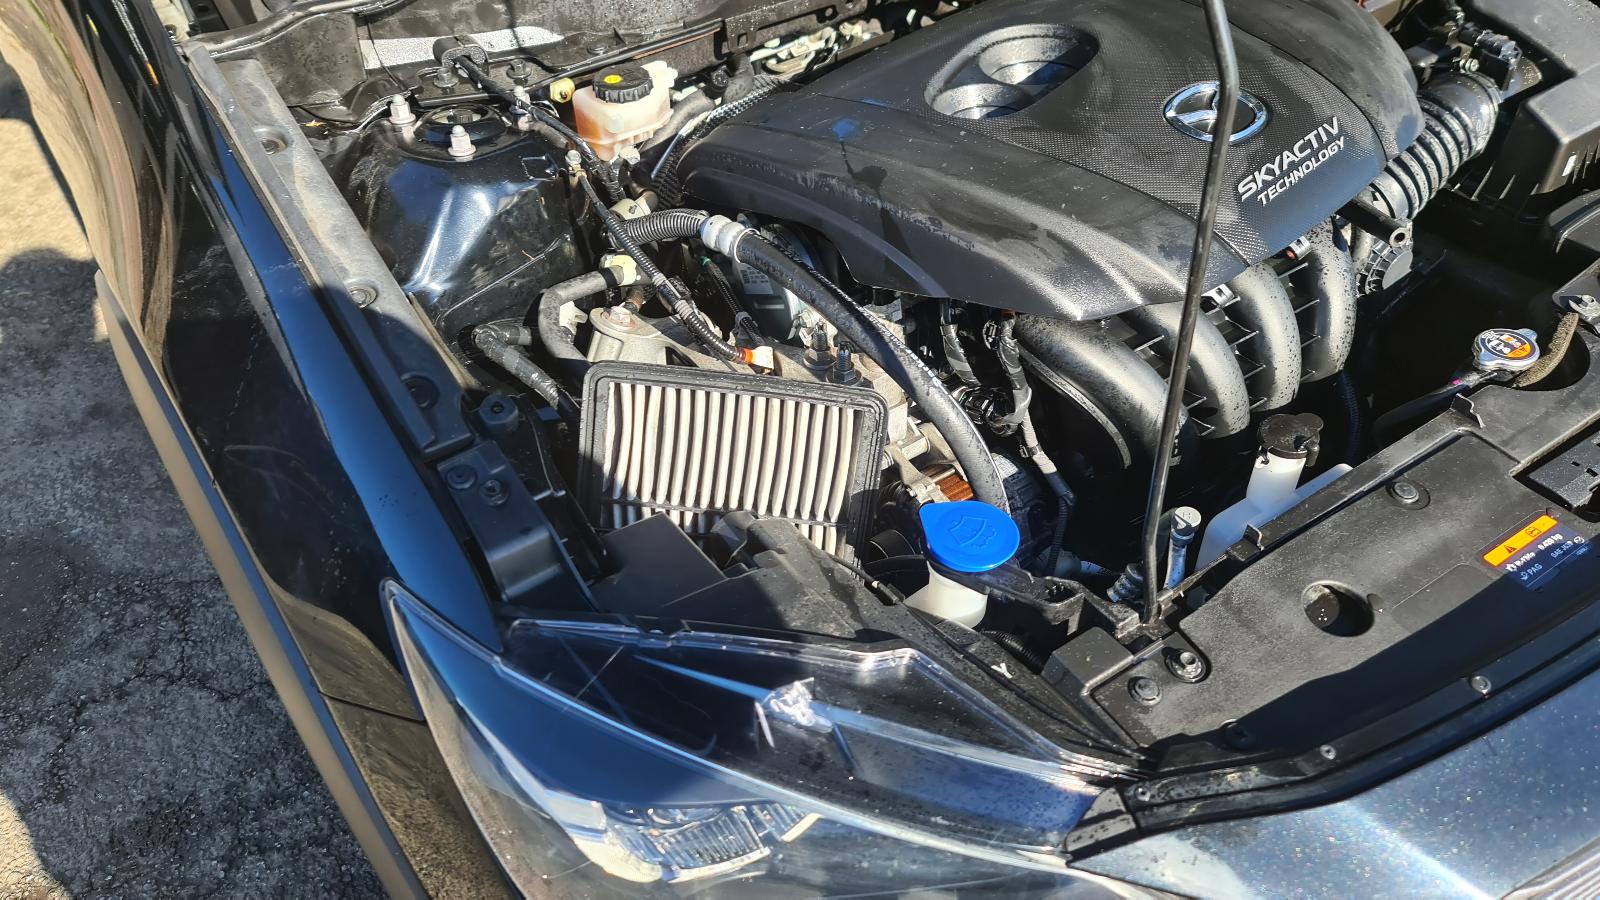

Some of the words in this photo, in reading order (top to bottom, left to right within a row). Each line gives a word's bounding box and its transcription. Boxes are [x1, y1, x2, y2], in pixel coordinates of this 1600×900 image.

[1237, 116, 1339, 202] SKYACTIV
[1257, 136, 1344, 207] TECHNOLOGY
[1526, 563, 1543, 576] PAG
